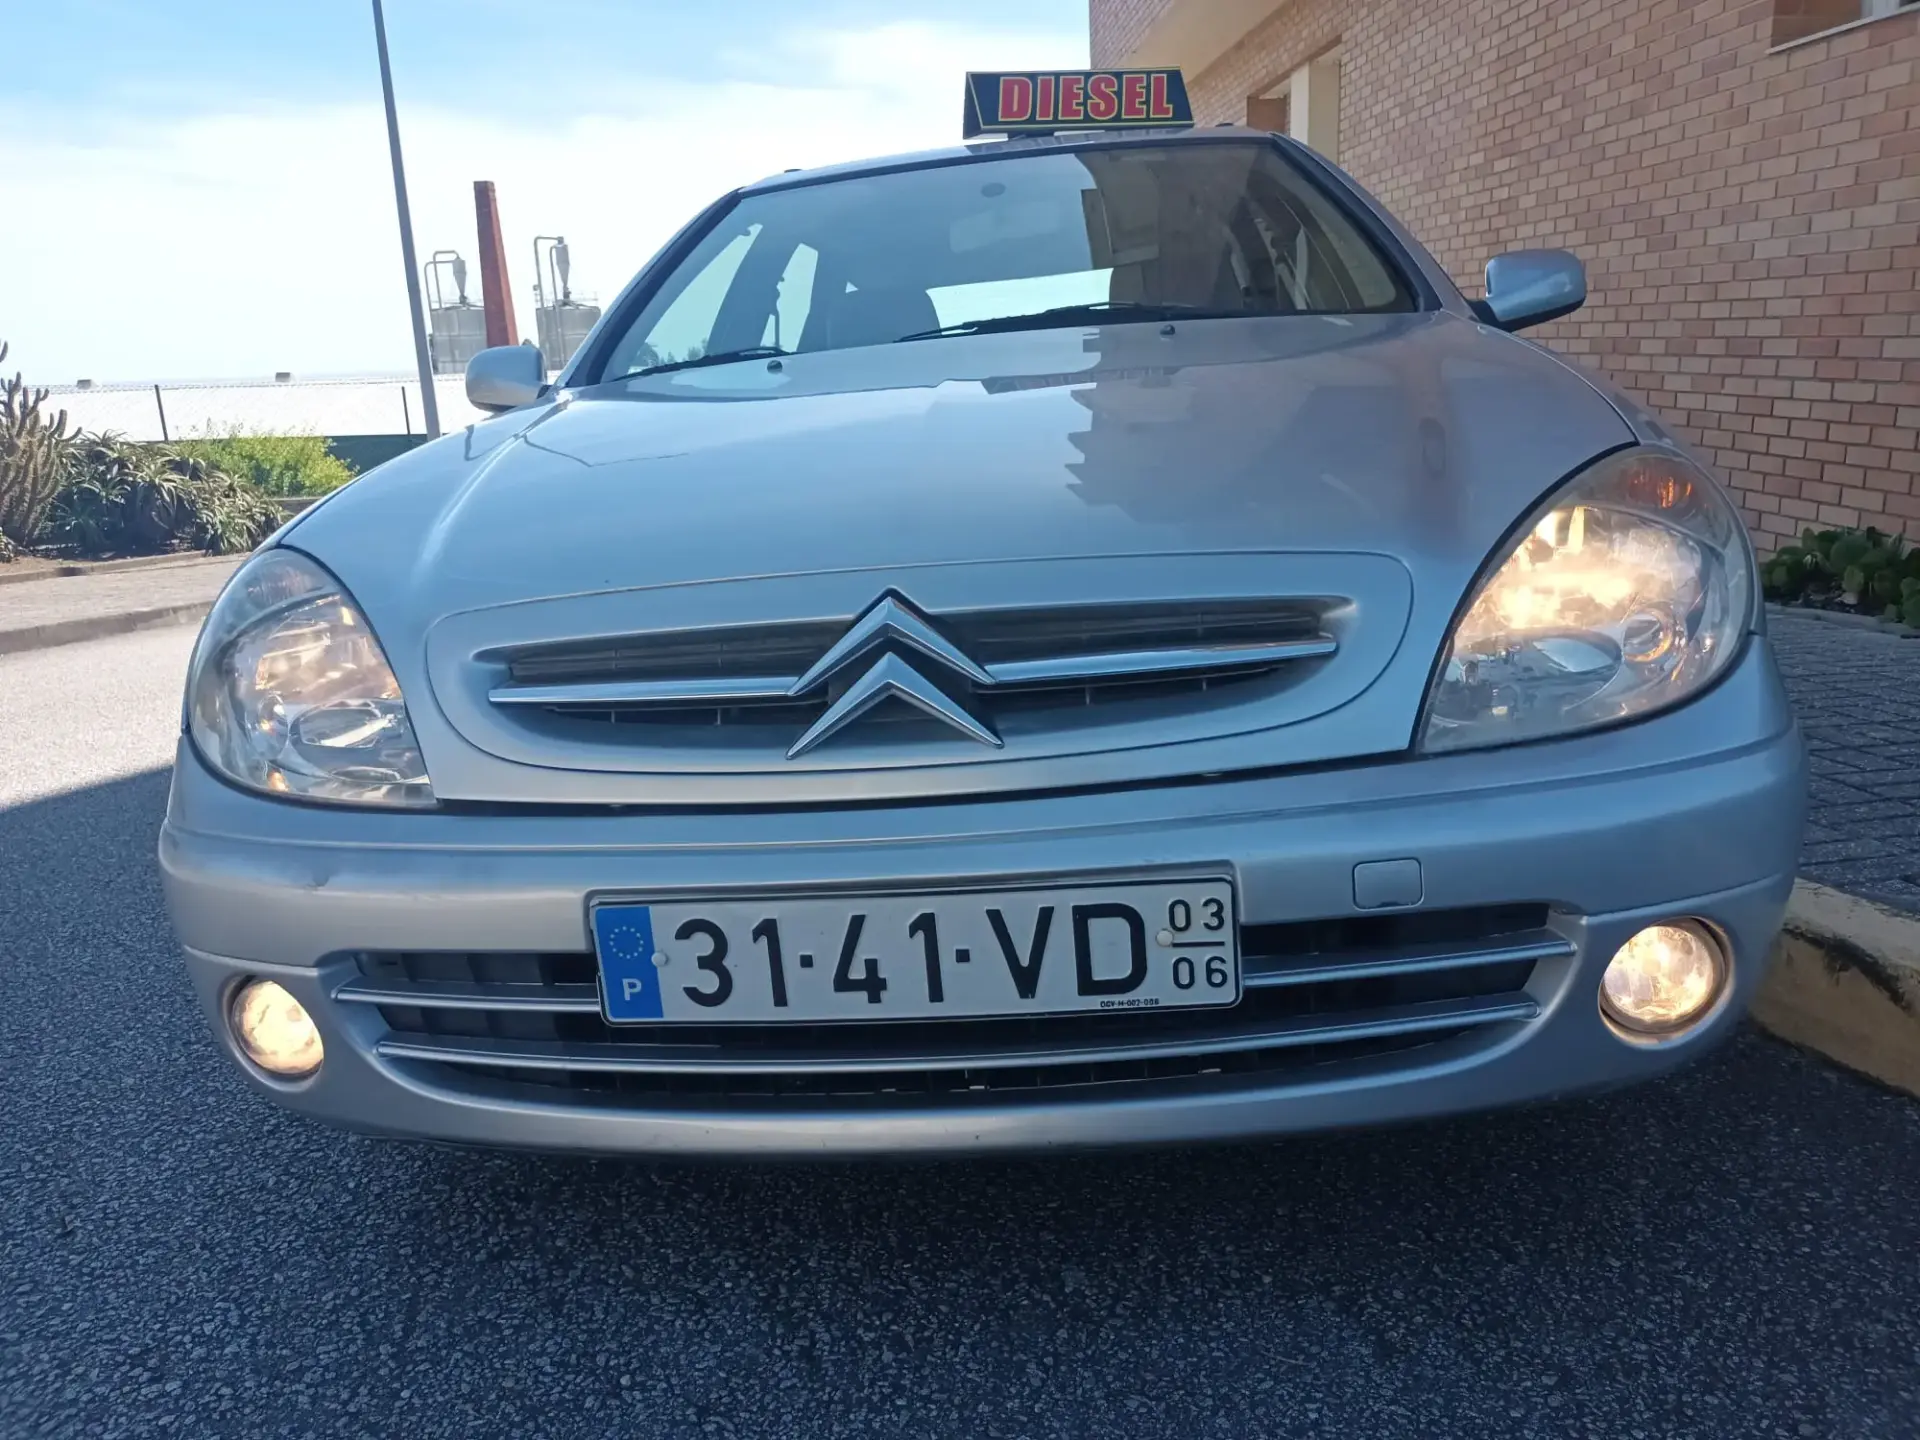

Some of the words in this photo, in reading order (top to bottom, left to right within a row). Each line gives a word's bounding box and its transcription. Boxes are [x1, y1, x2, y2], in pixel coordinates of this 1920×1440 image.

[998, 74, 1172, 121] DIESEL
[1168, 898, 1224, 931] 03
[1172, 956, 1228, 989] 06
[621, 978, 642, 1001] P
